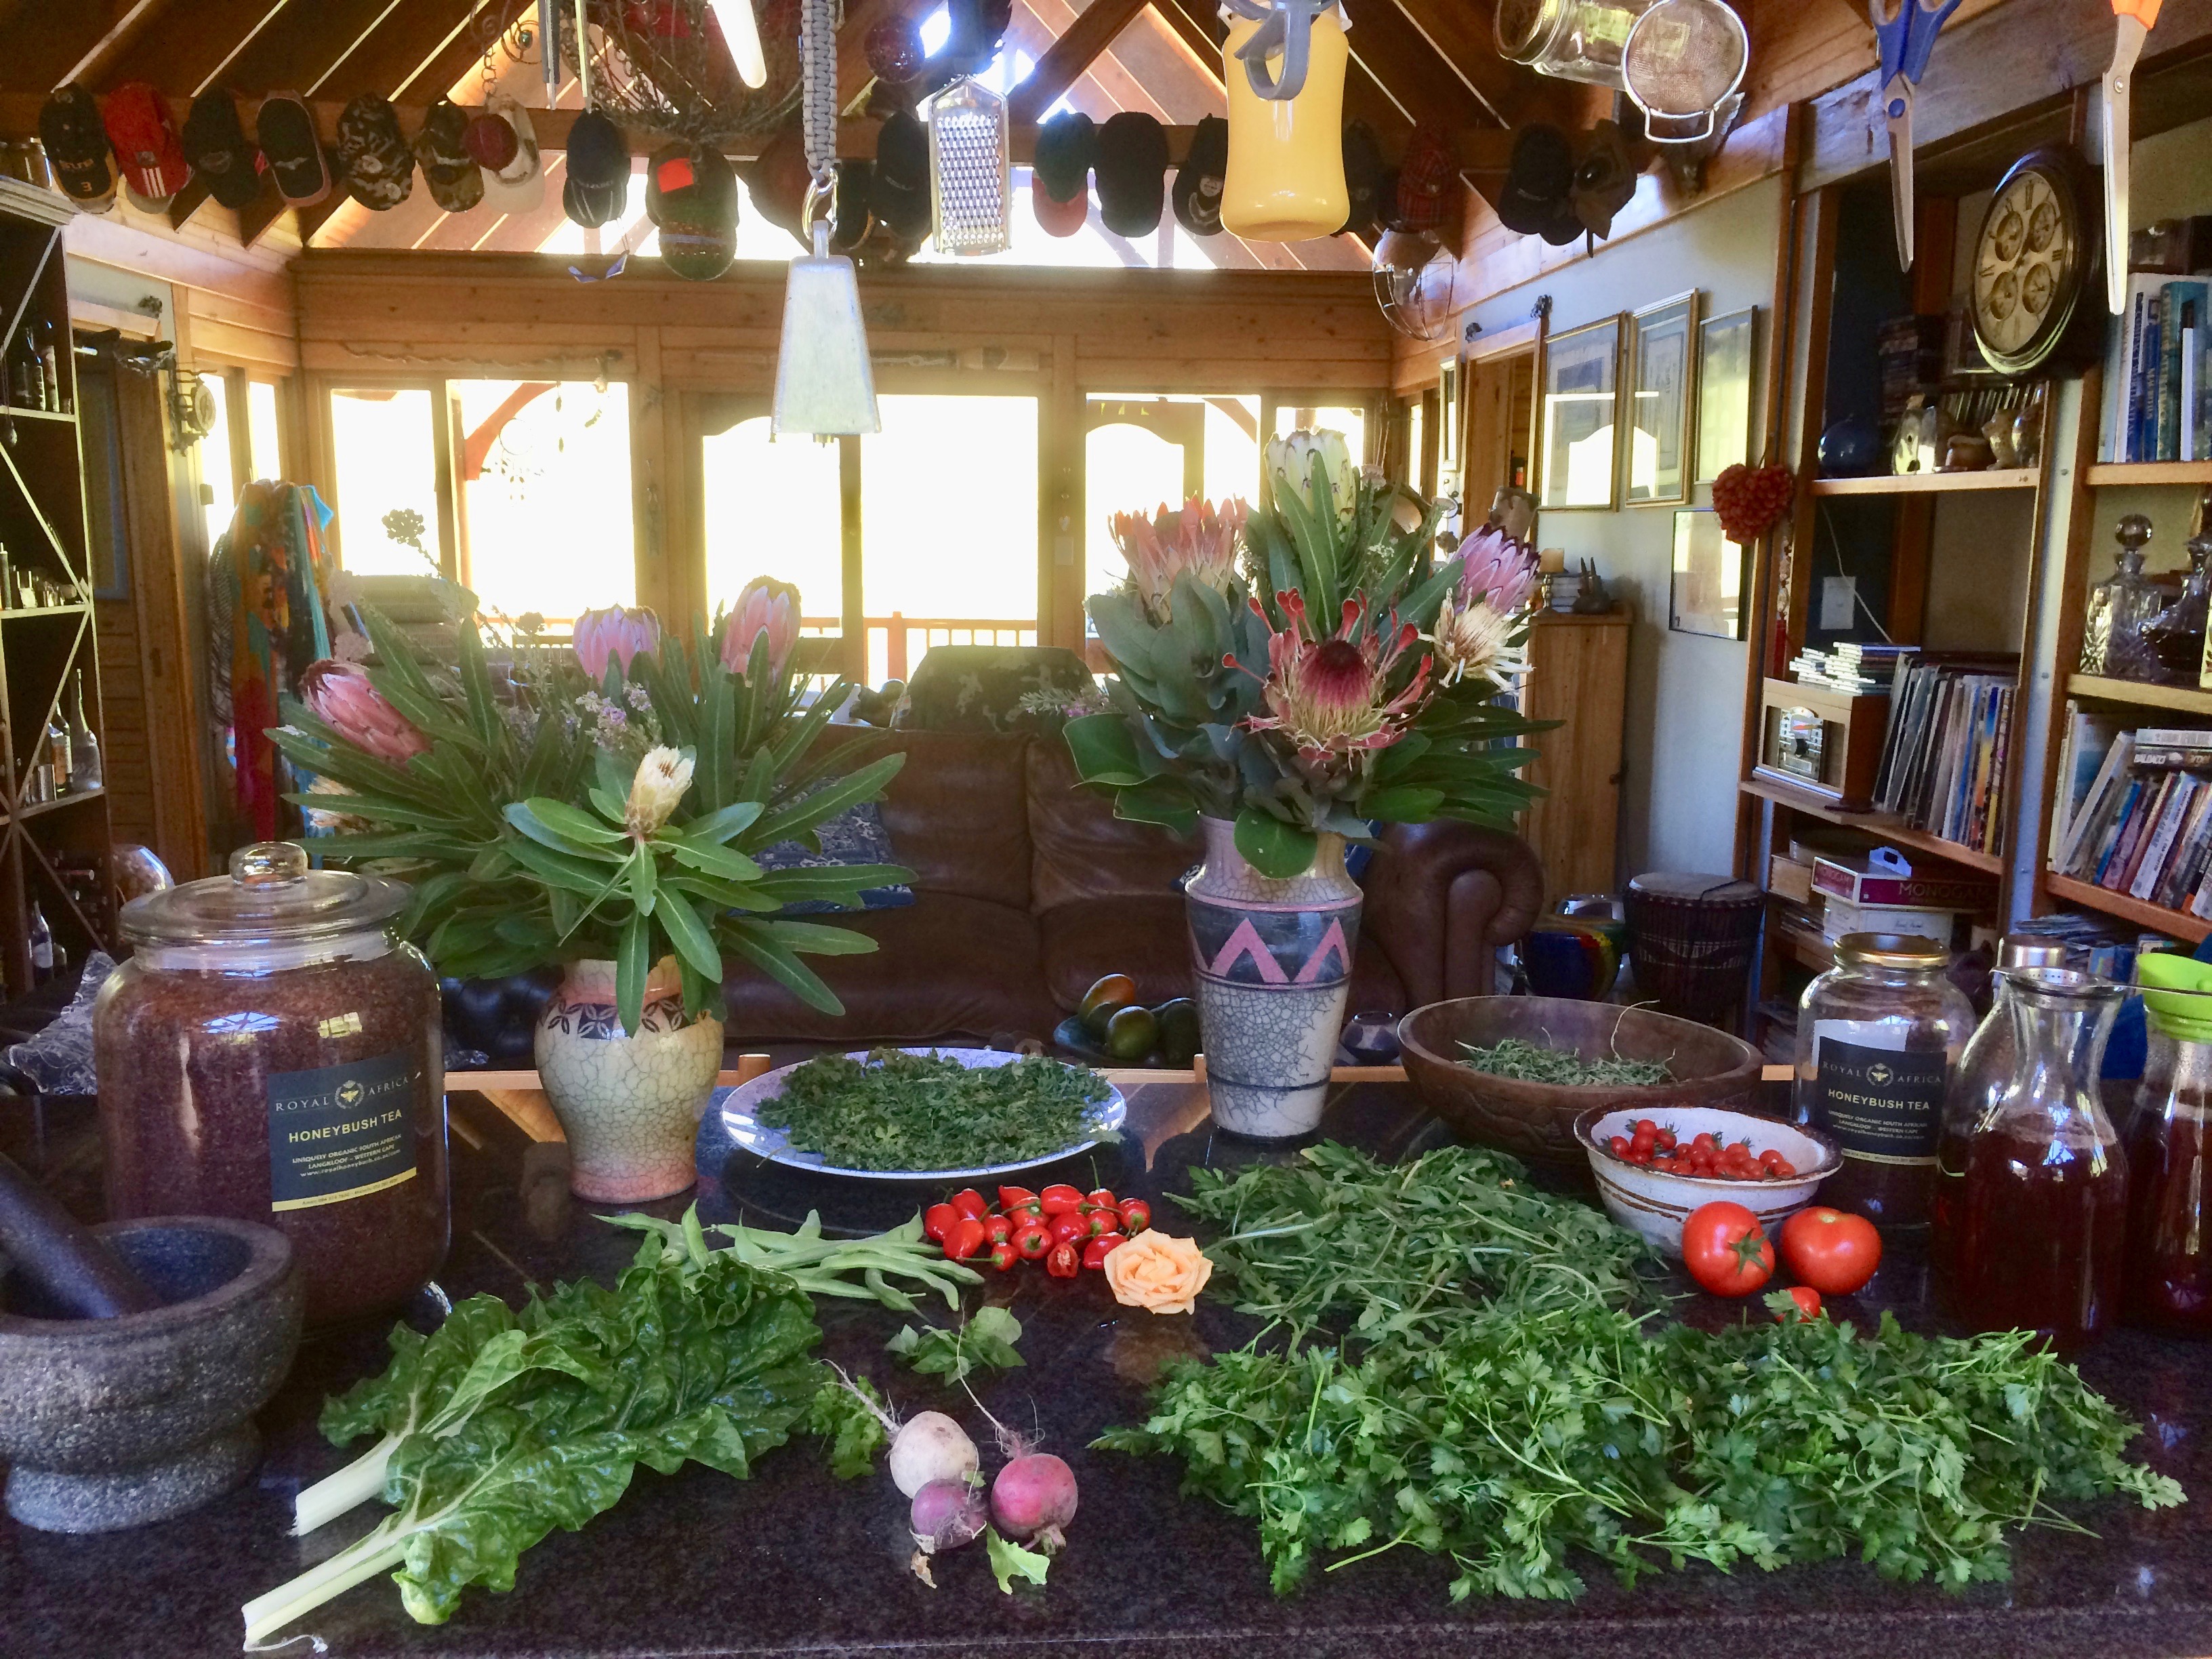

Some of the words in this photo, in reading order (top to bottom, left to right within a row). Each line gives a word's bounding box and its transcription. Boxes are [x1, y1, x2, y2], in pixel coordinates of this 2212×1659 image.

[1822, 1061, 1862, 1078] ROYAL
[1897, 1075, 1942, 1084] AFRICA
[276, 1096, 329, 1111] ROYAL
[369, 1076, 409, 1096] AFRICA
[1828, 1088, 1904, 1109] HONEYBUSH
[1907, 1101, 1930, 1111] TEA
[289, 1116, 377, 1143] HONEYBUSH
[381, 1108, 403, 1124] TEA
[328, 1147, 358, 1158] ORGANIC
[359, 1141, 380, 1152] SOUTH
[354, 1148, 381, 1160] WESTERN
